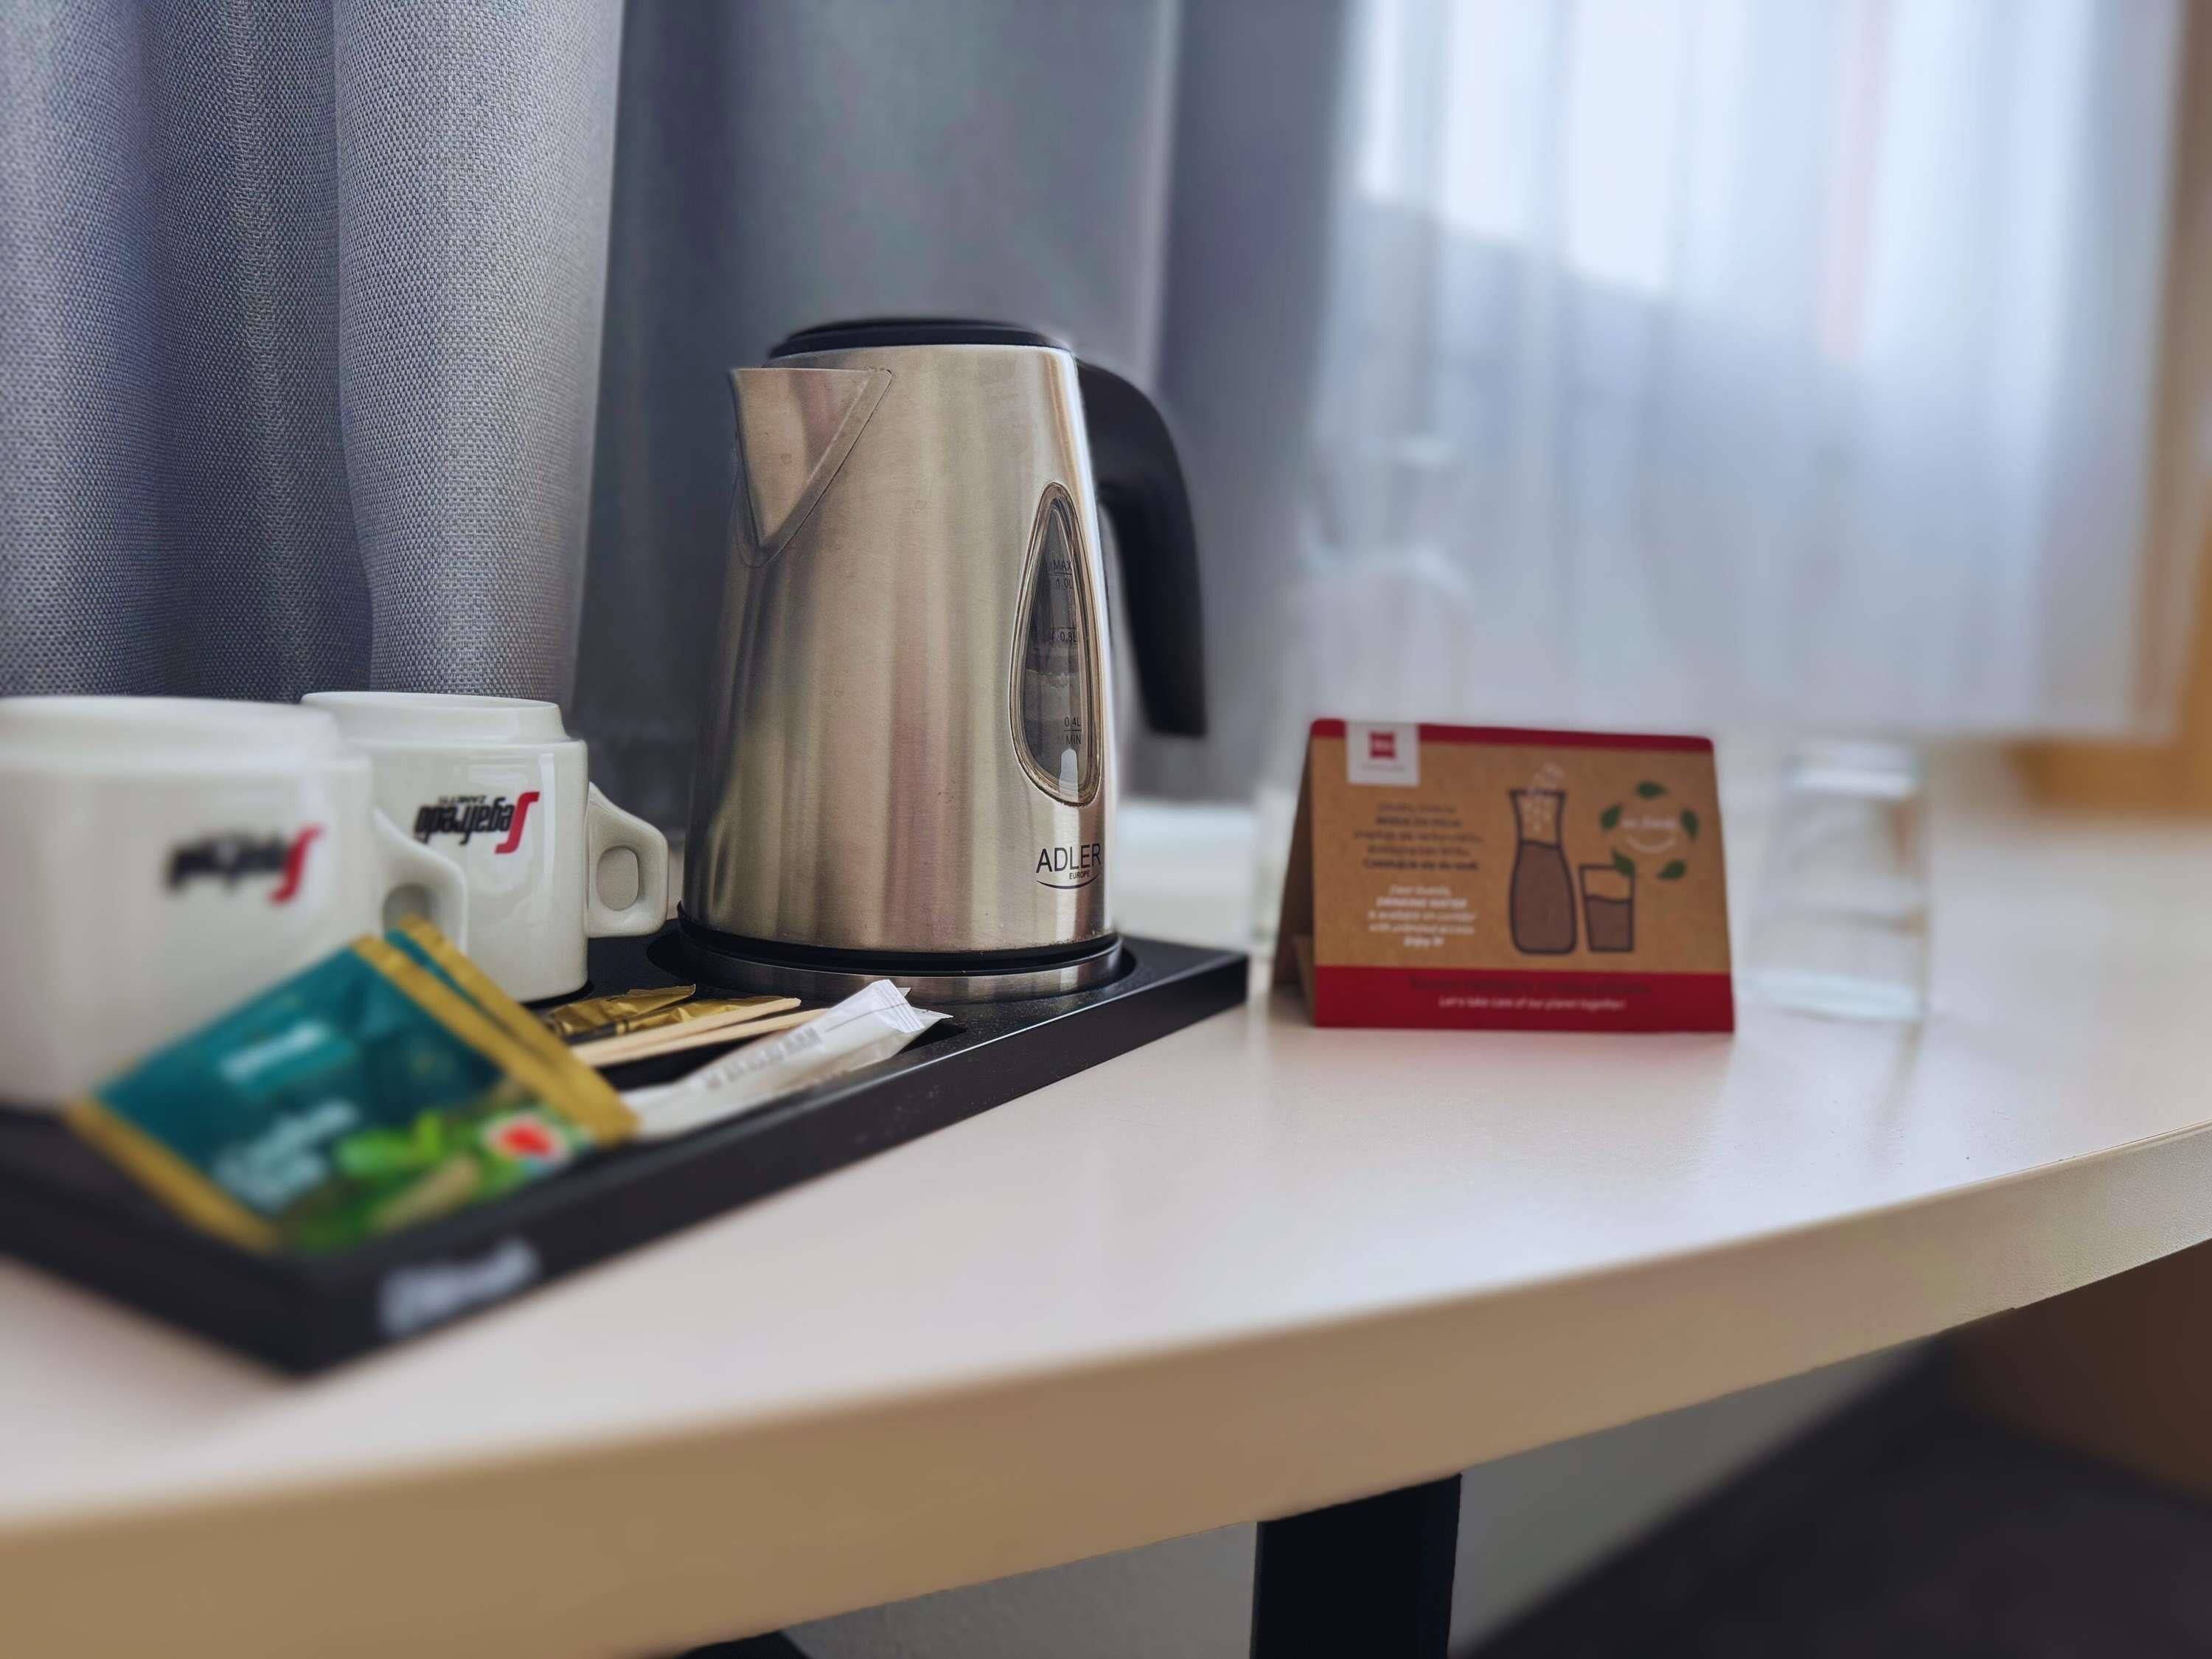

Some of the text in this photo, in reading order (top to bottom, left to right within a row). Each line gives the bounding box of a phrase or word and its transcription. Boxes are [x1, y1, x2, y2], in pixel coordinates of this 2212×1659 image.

[1064, 716, 1082, 727] 0.4L
[1066, 734, 1082, 745] MIN
[413, 790, 540, 855] Segafredo
[1035, 843, 1102, 874] ADLER
[1068, 870, 1091, 880] EUROPE
